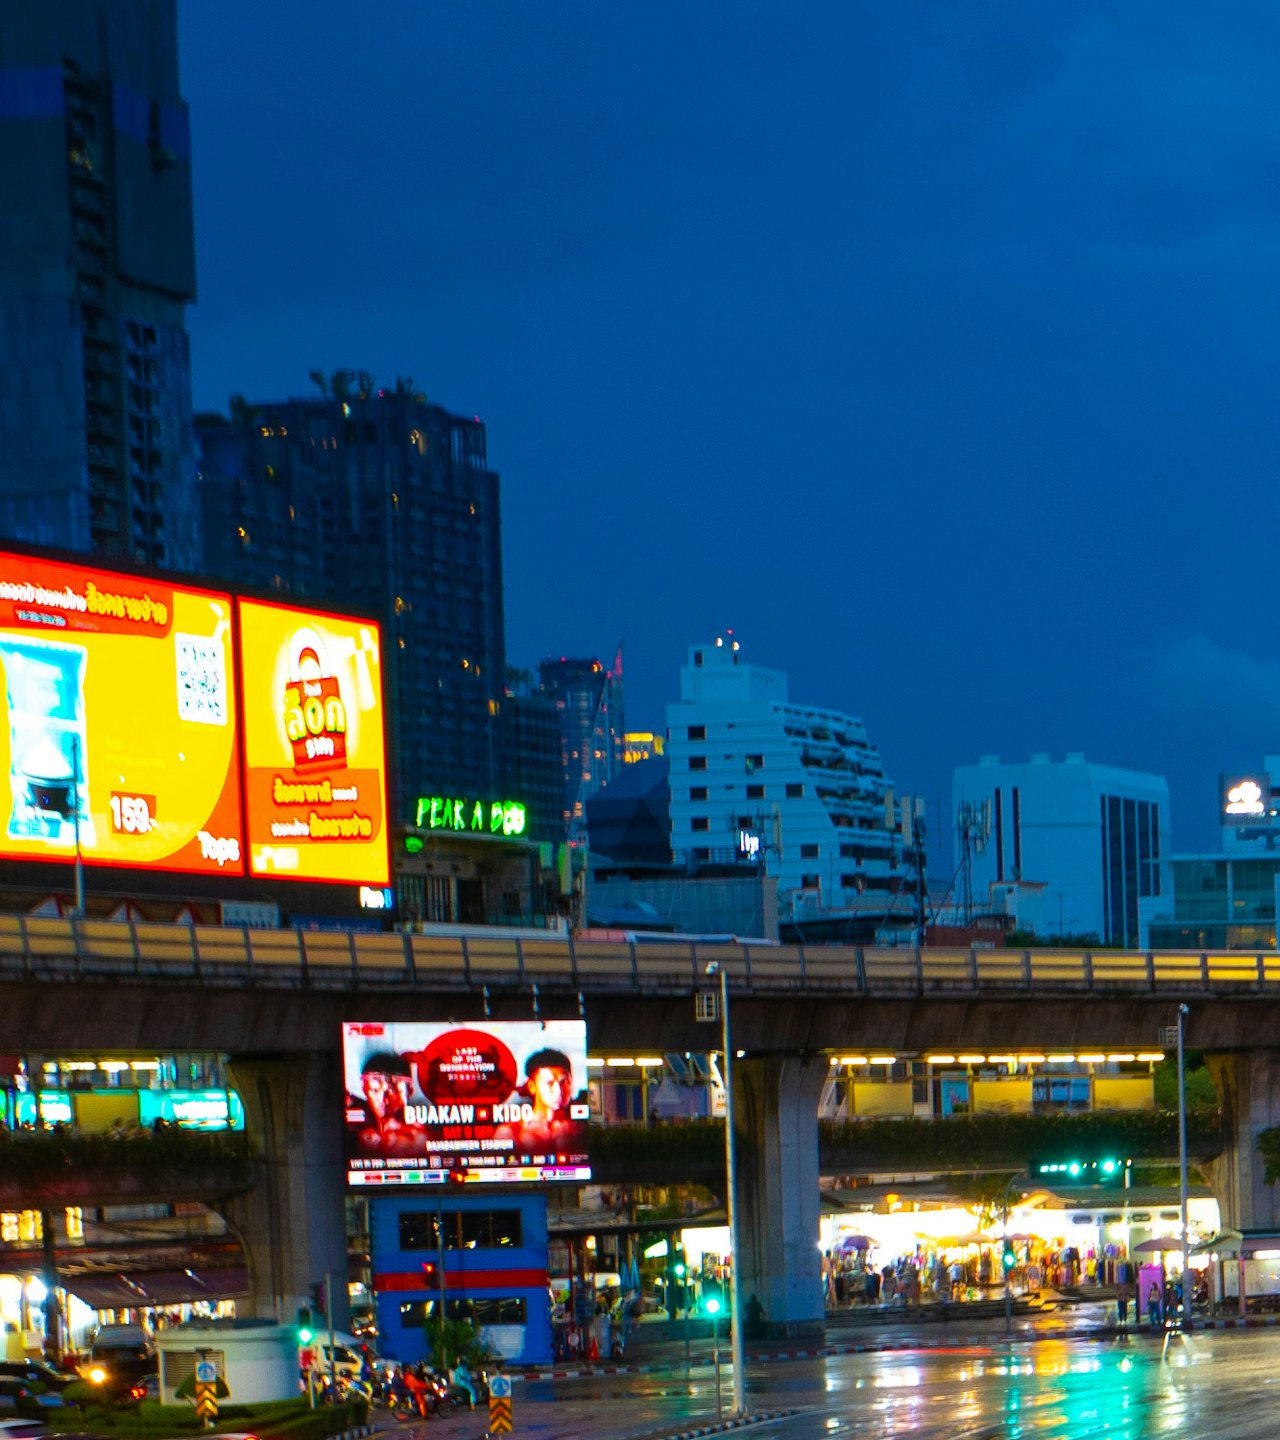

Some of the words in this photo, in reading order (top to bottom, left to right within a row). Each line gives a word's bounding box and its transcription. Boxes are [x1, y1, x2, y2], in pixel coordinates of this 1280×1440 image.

[471, 800, 483, 831] A
[404, 1105, 475, 1125] BUAKAW
[492, 1104, 534, 1124] KIDO
